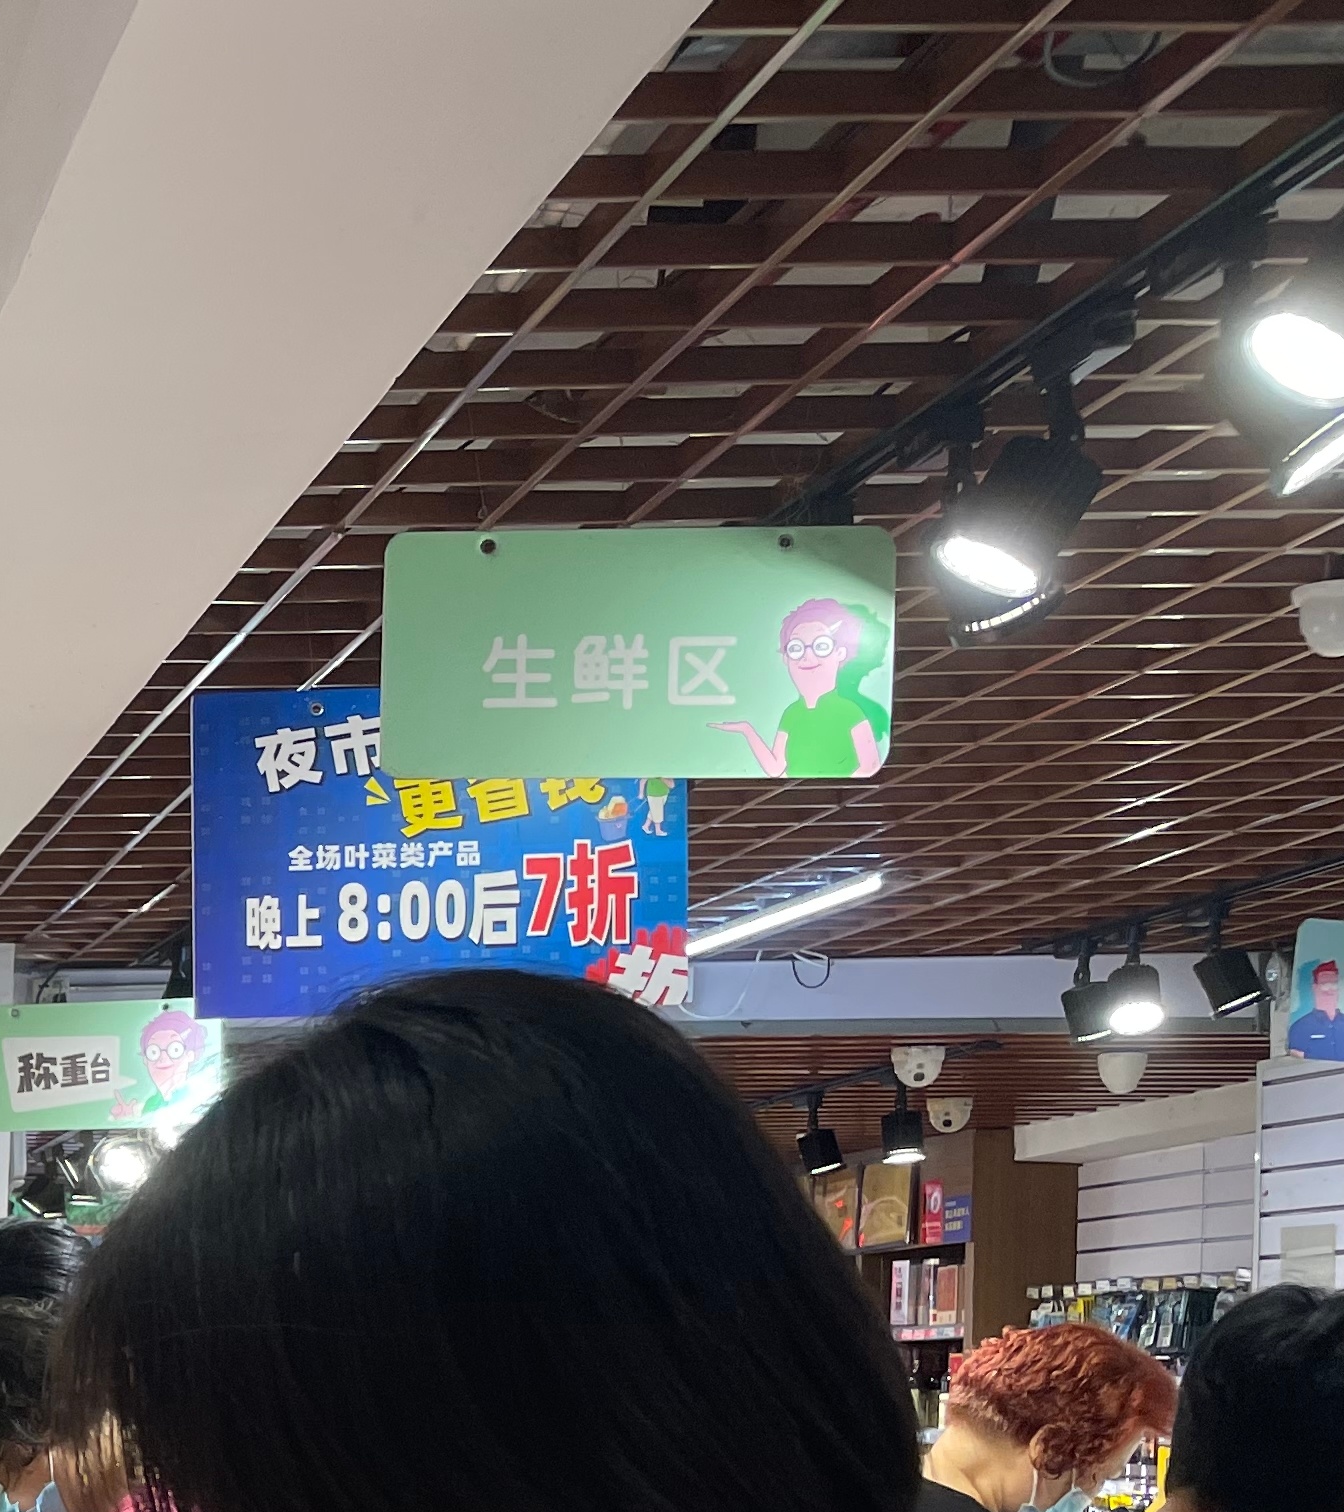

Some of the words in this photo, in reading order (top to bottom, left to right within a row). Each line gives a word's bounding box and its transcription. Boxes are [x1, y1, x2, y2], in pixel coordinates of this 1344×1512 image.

[482, 634, 737, 710] 生鲜区
[254, 714, 380, 793] 夜市
[288, 840, 481, 872] 全场叶菜类产品
[14, 1053, 113, 1094] 称重台
